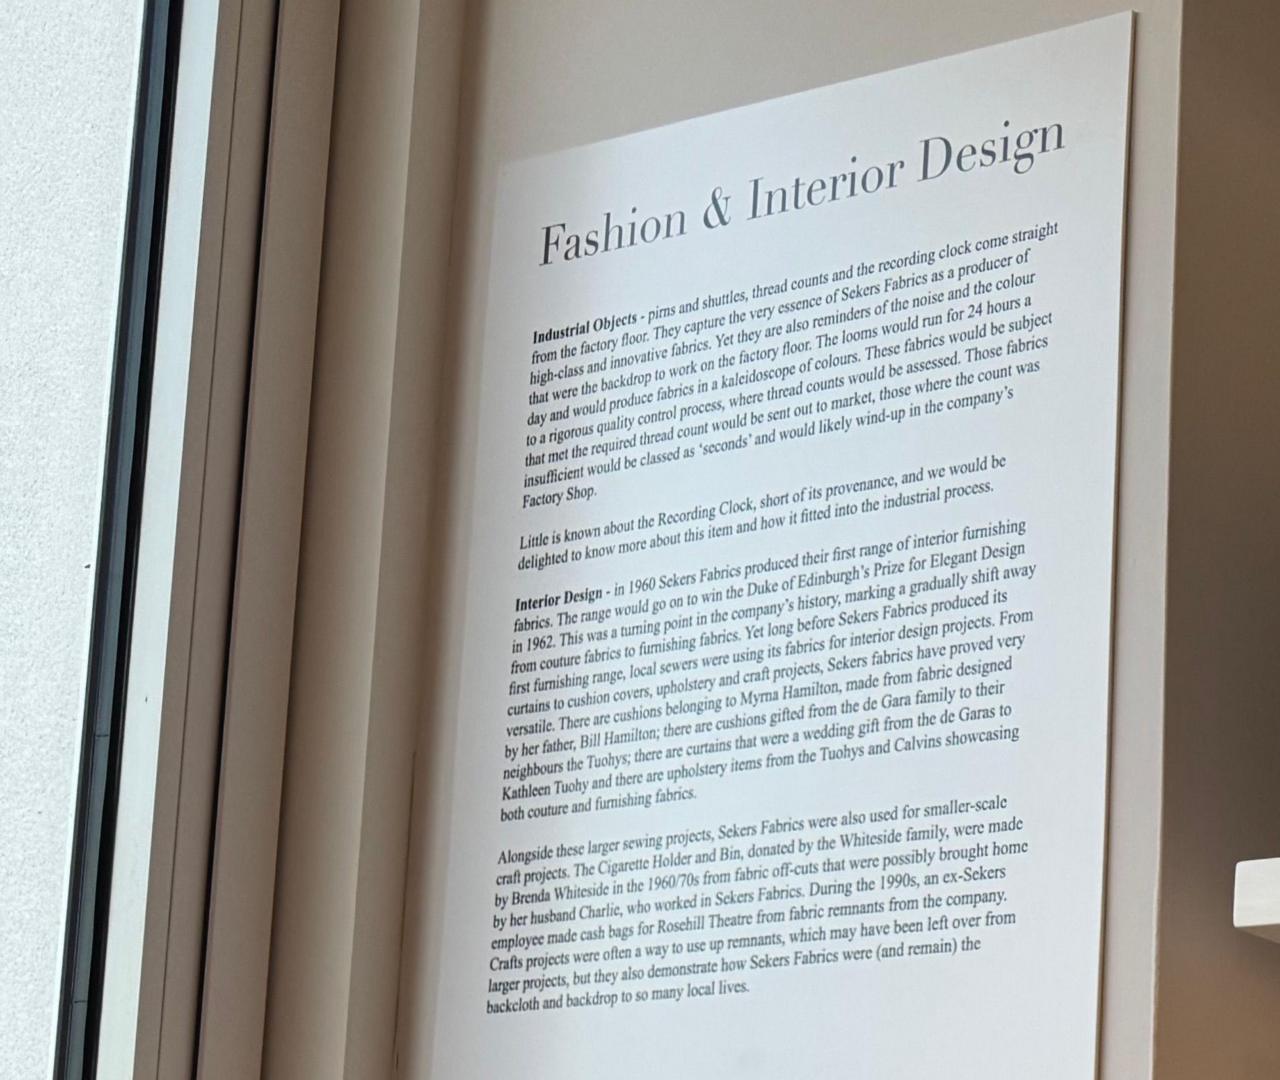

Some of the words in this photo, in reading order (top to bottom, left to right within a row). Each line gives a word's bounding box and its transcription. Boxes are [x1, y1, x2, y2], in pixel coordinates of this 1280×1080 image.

[537, 207, 687, 266] Fashion
[703, 187, 731, 229] &
[747, 156, 904, 220] Interior
[918, 120, 1065, 182] Design
[532, 319, 590, 344] Industrial
[592, 312, 637, 332] Objects
[647, 304, 676, 325] pirns
[678, 296, 699, 314] and
[701, 289, 748, 309] shuttles,
[751, 277, 787, 299] thread
[790, 272, 828, 290] counts
[831, 264, 853, 282] and
[856, 261, 875, 277] the
[877, 249, 935, 272] recording
[938, 239, 971, 259] clock
[974, 234, 1009, 251] come
[1011, 221, 1058, 244] straight
[528, 390, 549, 406] that
[551, 386, 578, 400] were
[580, 380, 598, 395] the
[600, 371, 652, 392] backdrop
[654, 368, 665, 381] to
[668, 359, 697, 378] work
[699, 359, 714, 372] on
[717, 353, 735, 368] the
[738, 346, 779, 365] factory
[782, 340, 812, 356] floor.
[815, 332, 838, 349] The
[841, 327, 878, 344] looms
[881, 313, 918, 335] would
[921, 313, 942, 328] run
[946, 307, 965, 323] for
[967, 301, 983, 319] 24
[986, 297, 1021, 315] hours
[1023, 295, 1031, 307] a
[524, 451, 545, 467] that
[547, 447, 568, 464] met
[571, 443, 588, 459] the
[590, 432, 636, 456] required
[639, 425, 674, 445] thread
[676, 421, 708, 439] count
[711, 411, 747, 432] would
[750, 410, 764, 425] be
[766, 406, 790, 422] sent
[793, 401, 812, 417] out
[816, 400, 828, 413] to
[830, 391, 875, 410] market,
[879, 385, 911, 401] those
[914, 377, 952, 394] where
[955, 371, 974, 387] the
[977, 364, 1012, 382] count
[1015, 360, 1040, 375] was
[519, 532, 549, 550] Little
[551, 529, 561, 544] is
[563, 526, 600, 543] known
[603, 519, 634, 535] about
[637, 514, 654, 530] the
[657, 504, 716, 526] Recording
[718, 496, 756, 515] Clock,
[759, 492, 789, 508] short
[791, 486, 807, 503] of
[808, 485, 822, 500] its
[824, 475, 897, 502] provenance,
[900, 466, 923, 484] and
[926, 466, 945, 479] we
[948, 455, 987, 476] would
[991, 453, 1006, 469] be
[521, 491, 564, 509] Factory
[565, 485, 597, 501] Shop.
[514, 593, 561, 612] Interior
[563, 586, 602, 605] Design
[613, 581, 624, 596] in
[629, 576, 656, 594] 1960
[658, 572, 696, 589] Sekers
[699, 563, 741, 583] Fabrics
[743, 552, 798, 580] produced
[801, 548, 829, 566] their
[832, 545, 855, 561] first
[859, 541, 893, 558] range
[895, 534, 911, 551] of
[912, 529, 959, 549] interior
[961, 518, 1026, 541] furnishing
[508, 680, 530, 696] first
[532, 671, 589, 692] furnishing
[591, 669, 626, 685] range,
[629, 660, 656, 679] local
[659, 658, 698, 674] sewers
[701, 653, 729, 667] were
[732, 647, 764, 664] using
[767, 643, 781, 658] its
[784, 637, 825, 656] fabrics
[828, 633, 847, 650] for
[849, 627, 895, 647] interior
[897, 621, 938, 640] design
[941, 615, 995, 638] projects.
[999, 609, 1033, 626] From
[504, 743, 519, 762] by
[520, 741, 540, 757] her
[541, 737, 576, 754] father,
[579, 731, 600, 749] Bill
[603, 727, 659, 746] Hamilton;
[663, 722, 692, 737] there
[694, 721, 712, 733] are
[714, 712, 766, 730] cushions
[768, 704, 804, 727] gifted
[807, 702, 837, 719] from
[840, 698, 859, 714] the
[862, 695, 877, 711] de
[880, 693, 911, 709] Gara
[914, 685, 956, 705] family
[959, 686, 972, 699] to
[975, 679, 1005, 697] their
[496, 844, 553, 866] Alongside
[555, 842, 584, 858] these
[587, 839, 620, 856] larger
[622, 833, 662, 850] sewing
[665, 828, 714, 849] projects,
[717, 823, 757, 839] Sekers
[759, 816, 804, 835] Fabrics
[807, 816, 837, 829] were
[840, 810, 866, 826] also
[869, 804, 898, 823] used
[901, 803, 921, 819] for
[923, 794, 1007, 817] smaller-scale
[490, 932, 544, 952] employee
[546, 927, 577, 945] made
[579, 924, 605, 941] cash
[608, 923, 633, 941] bags
[637, 920, 654, 935] for
[656, 914, 704, 934] Rosehill
[707, 913, 753, 928] Theatre
[755, 908, 785, 924] from
[788, 903, 824, 921] fabric
[827, 900, 884, 918] remnants
[888, 896, 918, 911] from
[922, 893, 942, 909] the
[945, 890, 1007, 908] company.
